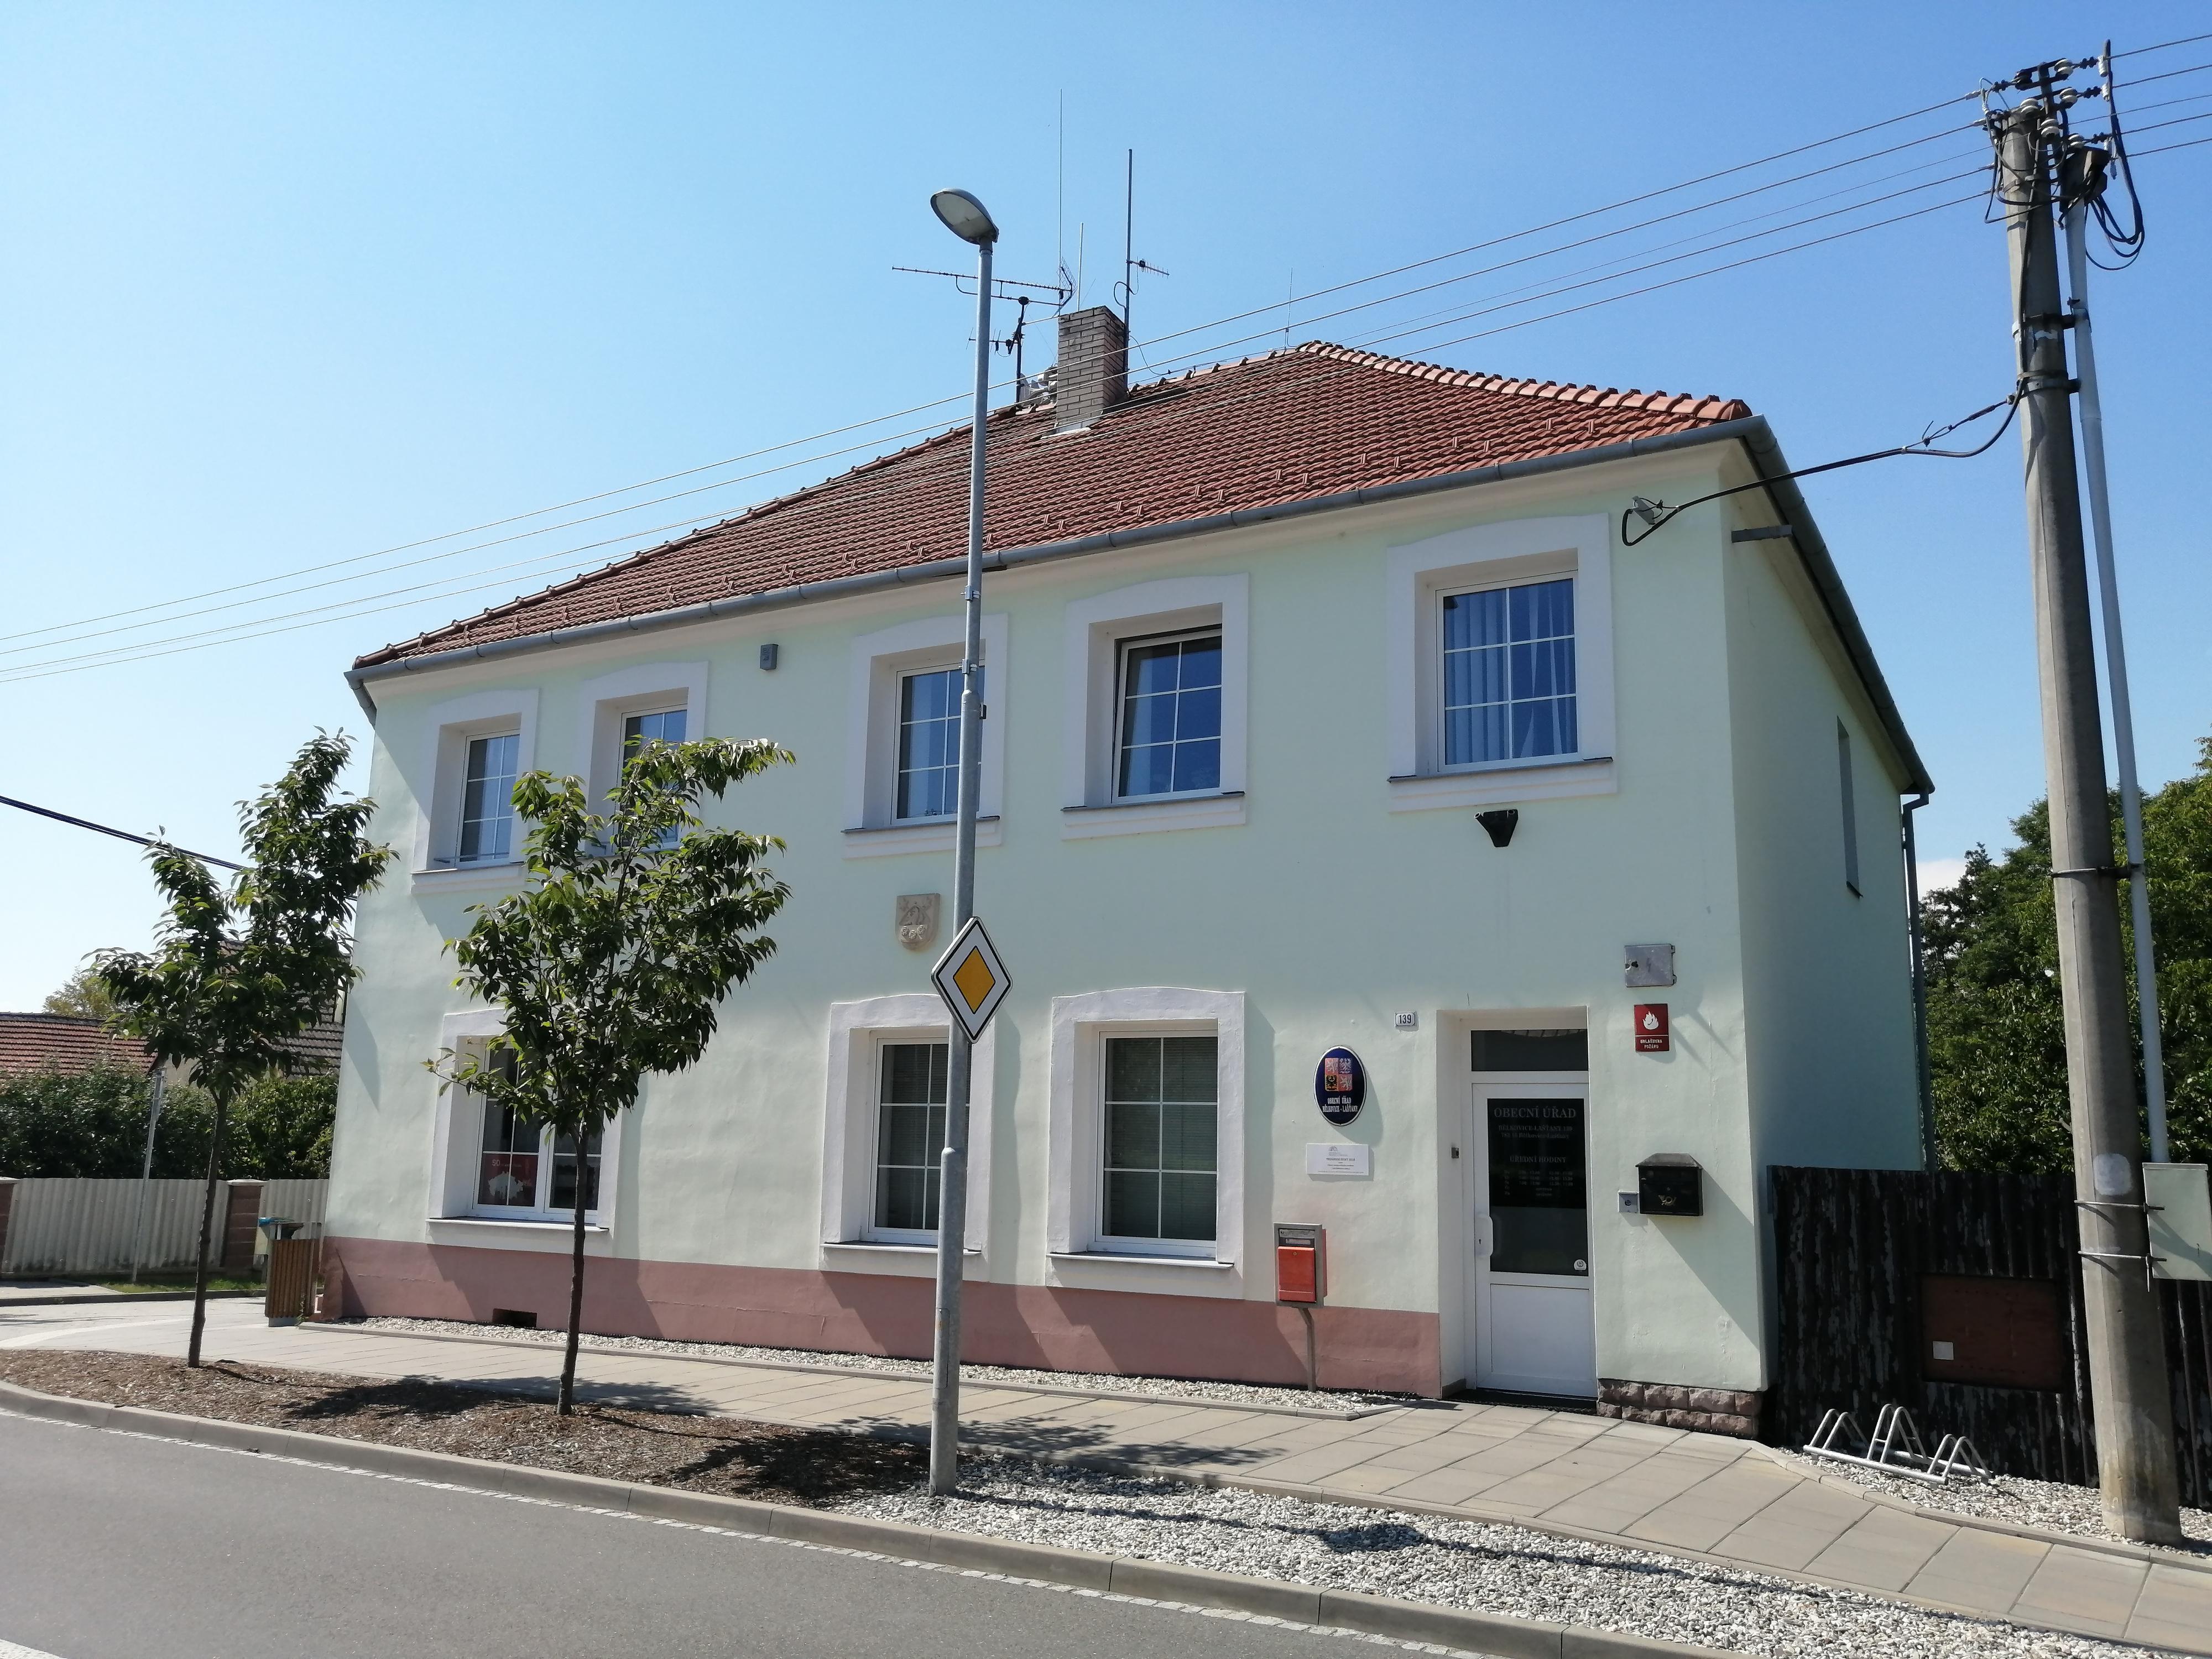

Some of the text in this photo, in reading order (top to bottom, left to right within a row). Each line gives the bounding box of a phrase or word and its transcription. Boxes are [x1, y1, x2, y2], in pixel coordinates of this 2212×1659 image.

[1399, 1014, 1411, 1024] 139
[1327, 1095, 1352, 1104] OBECNÍ ÚŘAD
[1494, 1105, 1577, 1118] OBECNÍ ÚŘAD
